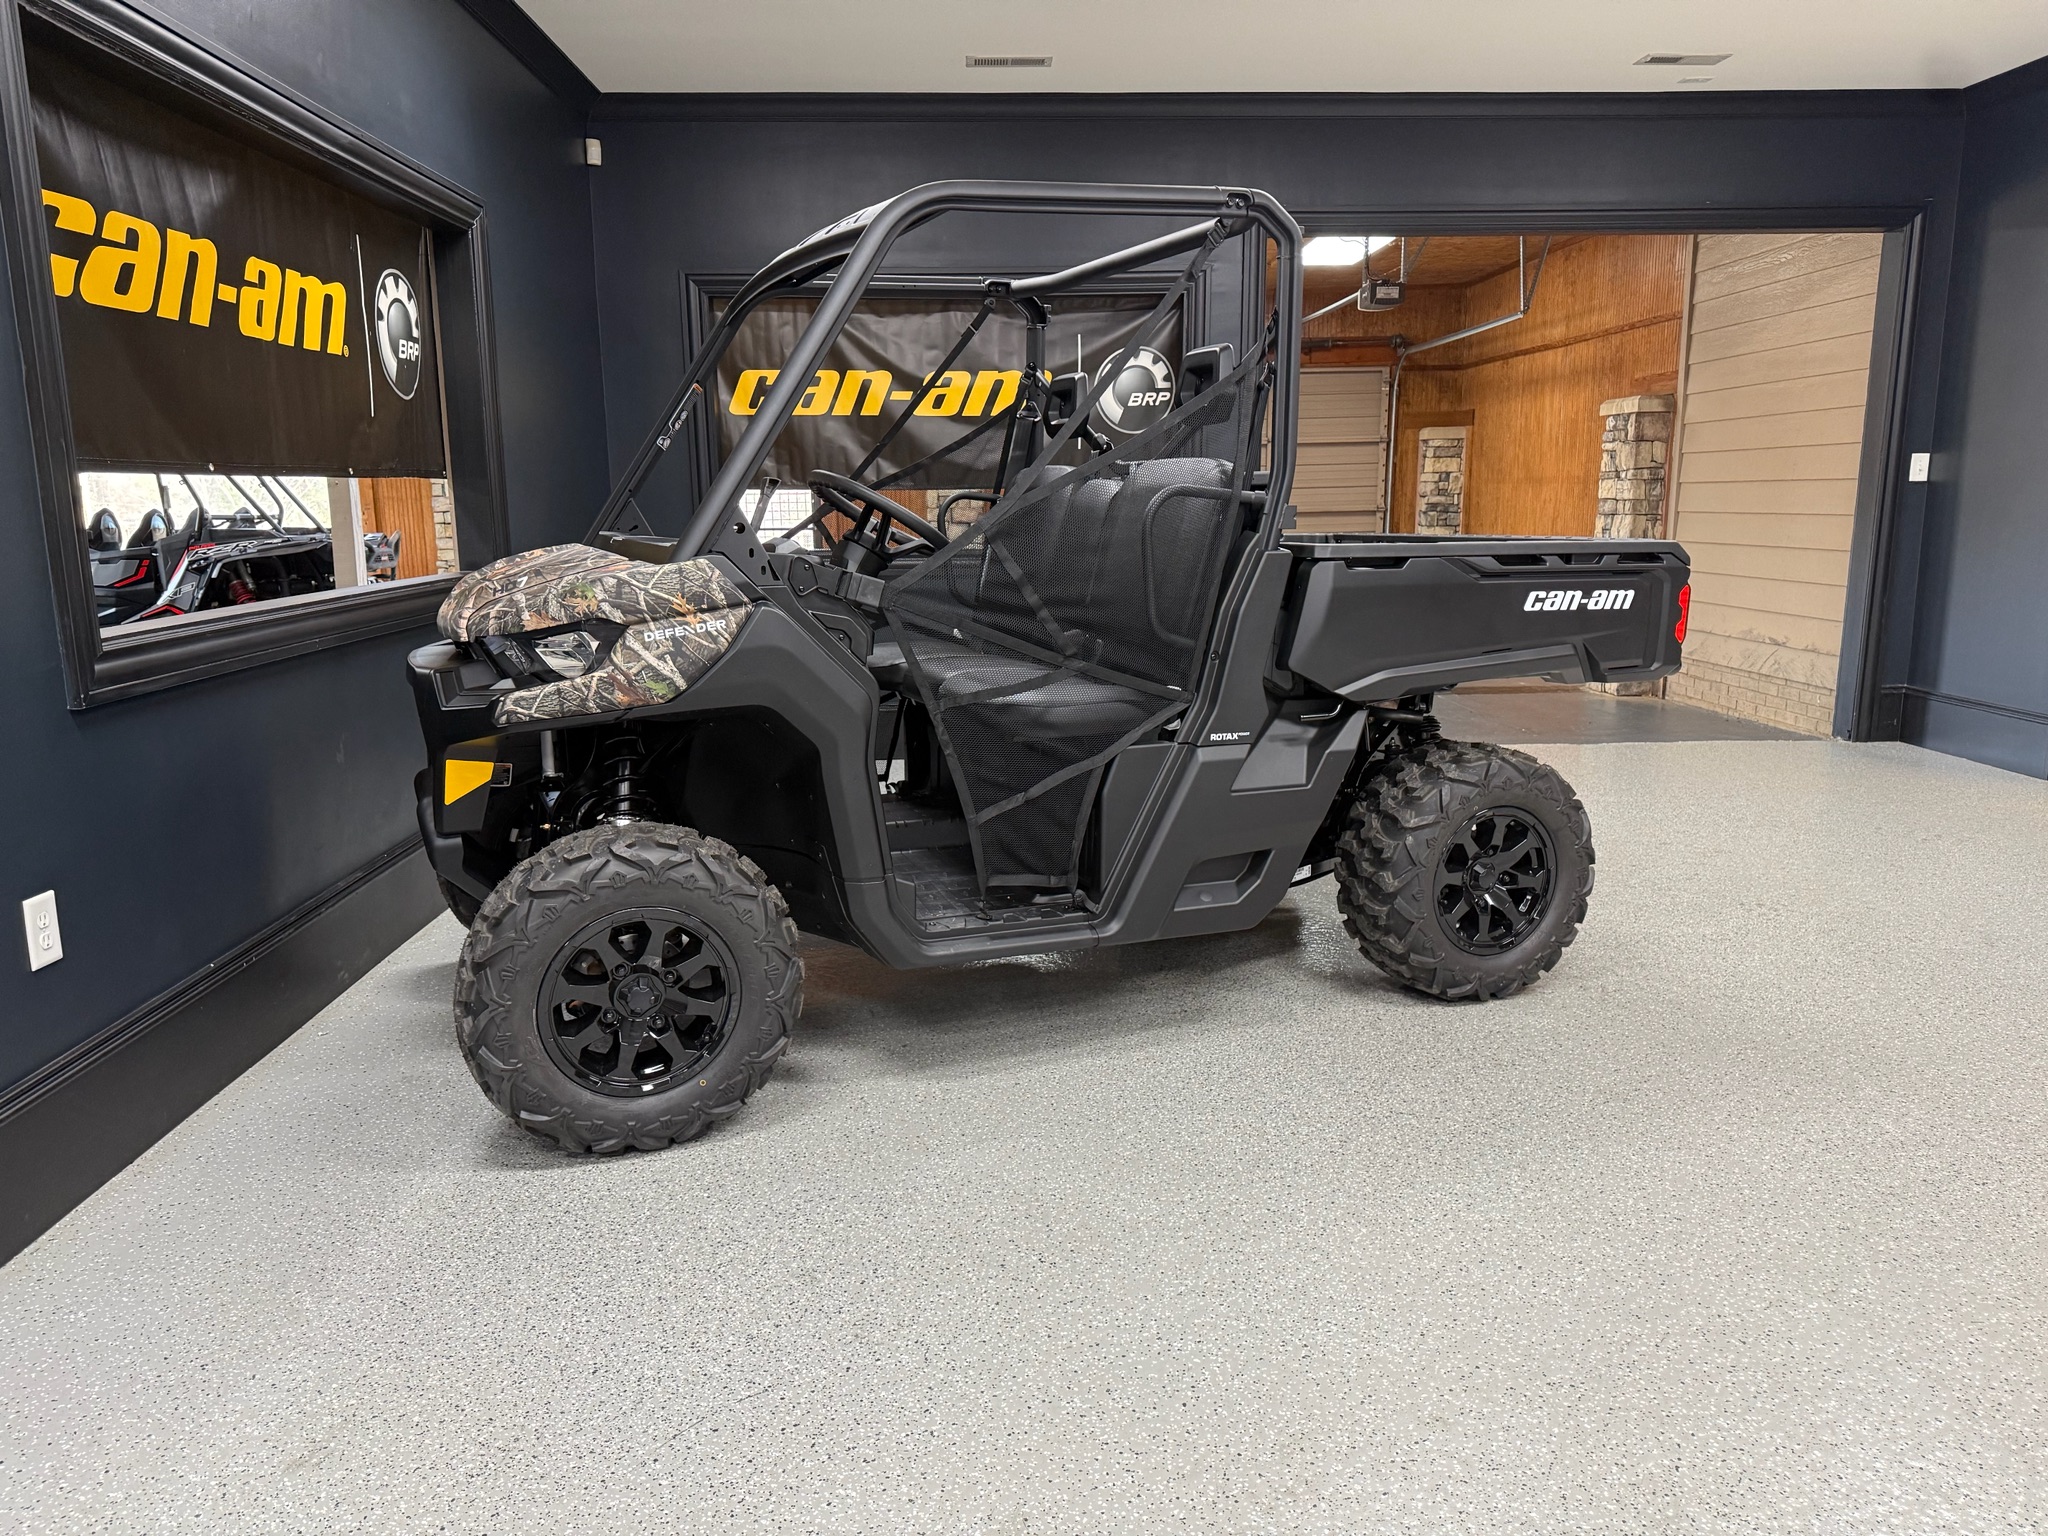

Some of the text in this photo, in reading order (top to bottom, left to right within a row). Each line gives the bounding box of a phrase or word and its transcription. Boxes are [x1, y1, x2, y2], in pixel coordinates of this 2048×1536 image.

[41, 188, 347, 356] can-am
[398, 338, 419, 361] BRP
[1127, 391, 1171, 407] BRP
[1523, 589, 1636, 611] can-am
[643, 619, 728, 642] DEFENDER
[1210, 732, 1239, 741] ROTAX
